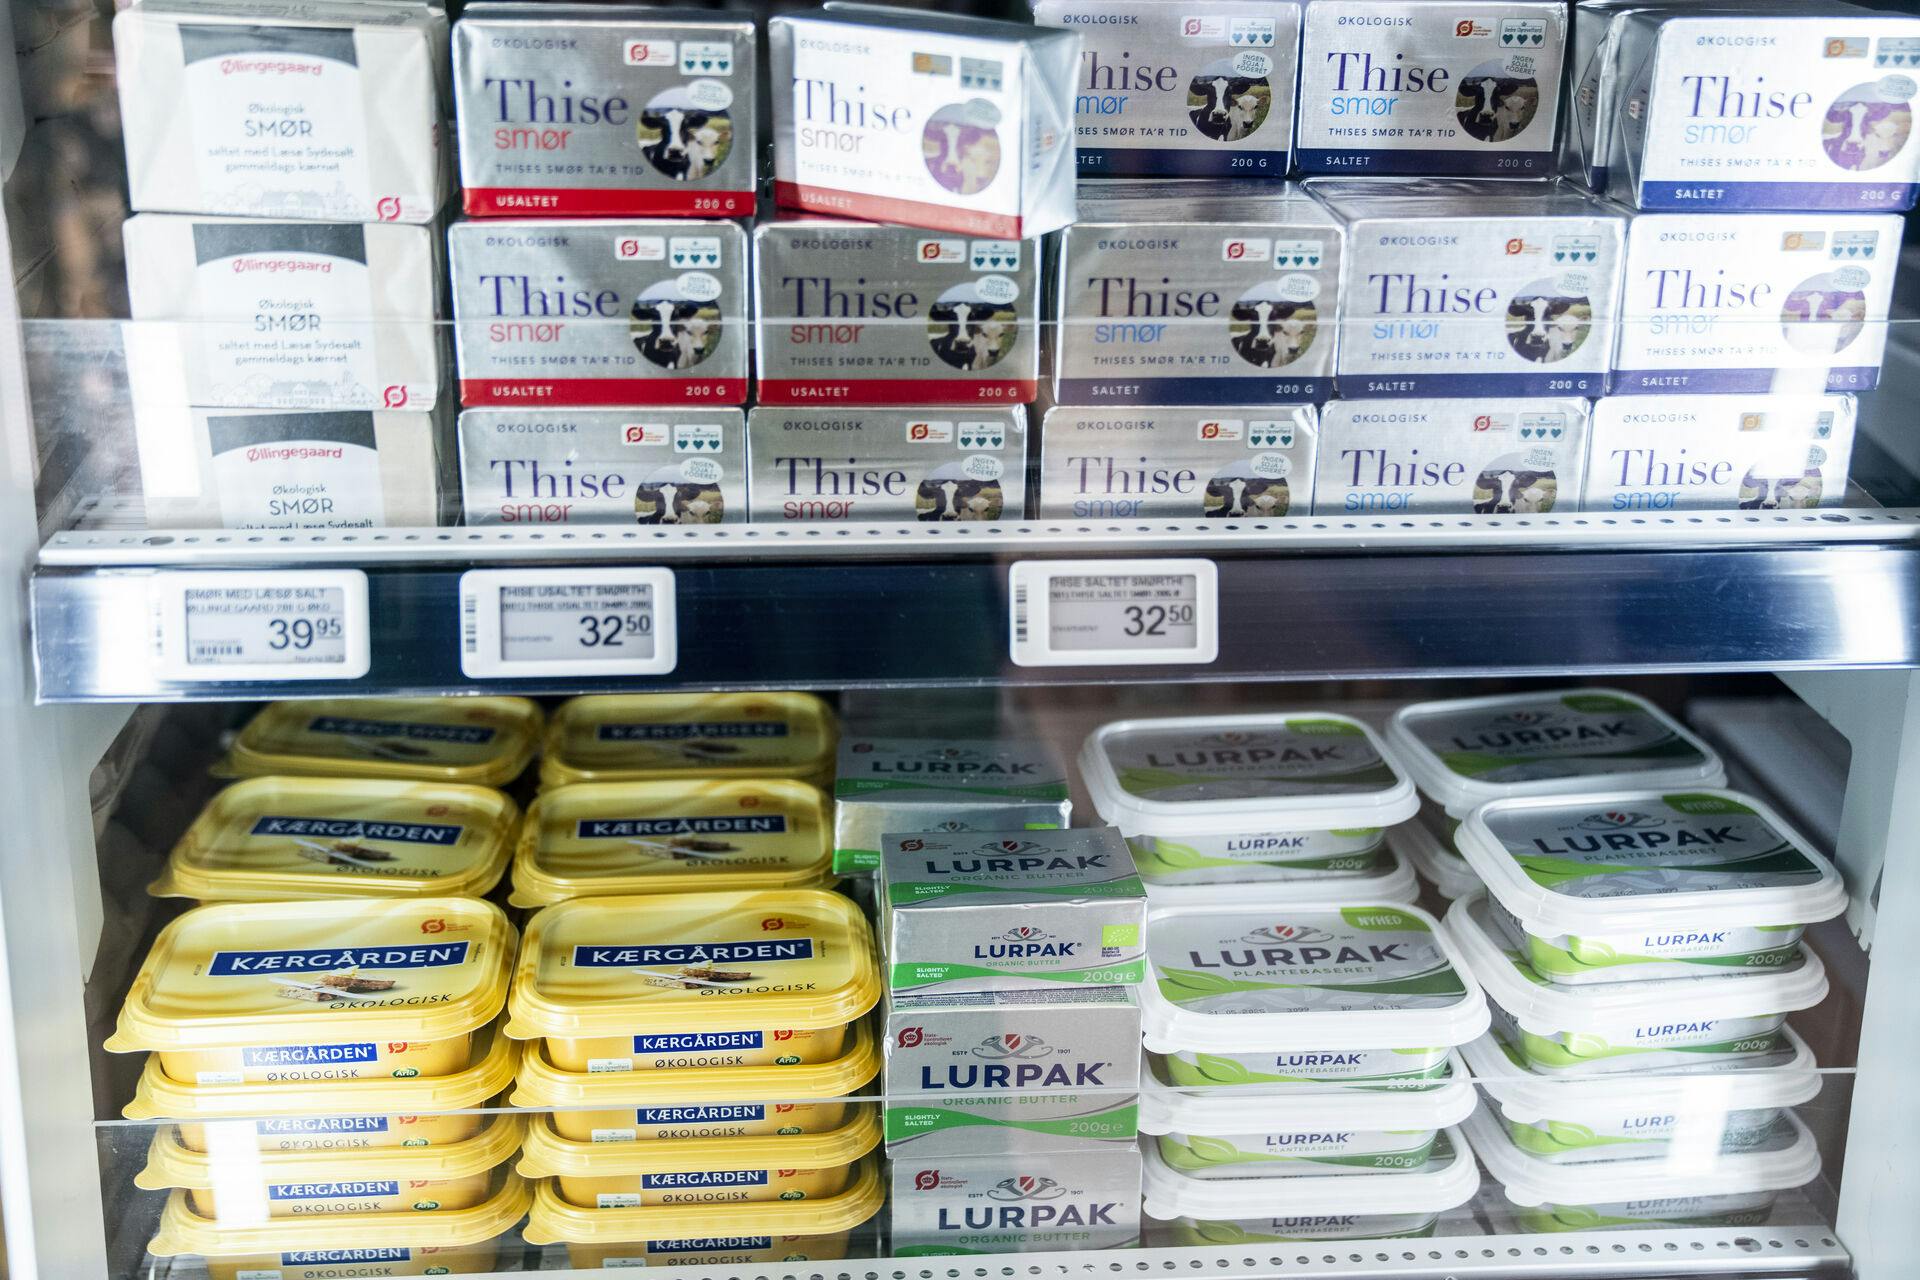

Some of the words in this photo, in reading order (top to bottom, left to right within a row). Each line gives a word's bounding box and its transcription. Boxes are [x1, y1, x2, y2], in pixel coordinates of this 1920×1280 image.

[1063, 14, 1138, 24] ØKOLOGISK
[1338, 17, 1413, 26] ØKOLOGISK
[492, 38, 578, 49] ØKOLOGISK
[1696, 36, 1777, 46] ØKOLOGISK
[220, 59, 323, 75] Øllingegaard
[1512, 55, 1535, 63] INGEN
[1081, 51, 1178, 91] hise
[1327, 52, 1449, 93] Thise
[1505, 65, 1537, 75] FODERET
[485, 78, 629, 126] Thise
[1075, 95, 1128, 114] mør
[1682, 76, 1812, 118] Thise
[793, 78, 911, 133] Thise
[1330, 95, 1399, 116] smør
[244, 119, 313, 138] SMØR
[1328, 128, 1367, 137] THISES
[1371, 128, 1404, 137] SMØR
[1408, 128, 1433, 138] TA'R
[1437, 129, 1456, 138] TID
[1684, 124, 1758, 144] smør
[495, 127, 574, 150] smør
[801, 126, 864, 153] smør
[1231, 158, 1253, 168] 200
[1258, 158, 1267, 168] G
[1326, 156, 1370, 166] SALTET
[1680, 158, 1721, 168] THISES
[1726, 158, 1760, 168] SMØR
[496, 164, 541, 175] THISES
[546, 164, 583, 175] SMØR
[622, 164, 645, 176] TID
[496, 196, 559, 208] USALTET
[1675, 189, 1724, 199] SALTET
[486, 237, 570, 248] ØKOLOGISK
[791, 239, 873, 250] ØKOLOGISK
[1097, 240, 1178, 250] ØKOLOGISK
[1379, 236, 1459, 246] ØKOLOGISK
[1659, 232, 1738, 242] ØKOLOGISK
[232, 259, 333, 274] Øllingegaard
[480, 275, 620, 318] Thise
[1368, 274, 1498, 314] Thise
[1647, 269, 1771, 309] Thise
[782, 277, 918, 319] Thise
[1088, 277, 1220, 318] Thise
[254, 314, 321, 333] SMØR
[489, 321, 565, 342] smør
[790, 322, 864, 344] smør
[1094, 322, 1167, 343] smør
[790, 357, 833, 367] THISES
[839, 357, 874, 367] SMØR
[910, 357, 931, 367] TID
[1094, 356, 1135, 366] THISES
[1140, 356, 1174, 366] SMØR
[1210, 355, 1230, 366] TID
[1091, 385, 1140, 396] SALTET
[1368, 381, 1416, 392] SALTET
[1642, 377, 1689, 388] SALTET
[492, 386, 554, 397] USALTET
[791, 386, 850, 397] USALTET
[783, 421, 863, 431] ØKOLOGISK
[1077, 420, 1155, 431] ØKOLOGISK
[1352, 414, 1428, 424] ØKOLOGISK
[1623, 413, 1697, 424] ØKOLOGISK
[497, 423, 578, 433] ØKOLOGISK
[246, 448, 342, 462] Øllingegaard
[1067, 456, 1196, 495] Thise
[1341, 449, 1465, 487] Thise
[1611, 448, 1732, 487] Thise
[490, 459, 626, 499] Thise
[775, 457, 906, 496] Thise
[272, 485, 327, 497] Økologisk
[269, 498, 334, 516] SMØR
[1072, 498, 1144, 518] smør
[1344, 491, 1413, 511] smør
[1612, 490, 1681, 510] smør
[500, 503, 573, 523] smør
[784, 500, 855, 520] smør
[1085, 576, 1128, 587] SALTET
[296, 588, 326, 599] SALT
[1124, 605, 1166, 636] 32
[1169, 604, 1193, 622] 50
[269, 618, 314, 650] 39
[316, 617, 341, 636] 95
[580, 615, 623, 647] 32
[626, 614, 650, 633] 50
[1452, 722, 1637, 751] LURPAK
[1147, 745, 1345, 767] LURPAK
[872, 760, 1036, 775] LURPAK
[267, 817, 445, 842] KÆRGÅRDEN
[594, 816, 772, 836] KÆRGÅRDEN
[1228, 837, 1306, 851] LURPAK
[1533, 826, 1746, 855] LURPAK
[1584, 848, 1718, 862] PLANTEBASERET
[926, 854, 1109, 874] LURPAK
[1357, 915, 1402, 926] NYHED
[1644, 931, 1728, 948] LURPAK
[593, 943, 798, 965] KÆRGÅRDEN
[975, 942, 1076, 959] LURPAK
[1189, 942, 1408, 969] LURPAK
[231, 946, 453, 972] KÆRGÅRDEN
[986, 959, 1025, 968] ORGANIC
[1027, 958, 1061, 967] BUTTER
[1233, 965, 1375, 978] PLANTEBASERET
[701, 981, 817, 997] ØKOLOGISK
[330, 993, 453, 1010] ØKOLOGISK
[1635, 1021, 1715, 1039] LURPAK
[643, 1032, 756, 1051] KÆRGÅRDEN
[252, 1045, 370, 1064] KÆRGÅRDEN
[655, 1055, 743, 1068] ØKOLOGISK
[778, 1056, 799, 1065] Arla
[1276, 1053, 1362, 1067] LURPAK
[267, 1068, 359, 1081] ØKOLOGISK
[922, 1062, 1106, 1089] LURPAK
[1278, 1066, 1359, 1074] PLANTEBASERET
[943, 1095, 1013, 1106] ORGANIC
[1020, 1094, 1078, 1105] BUTTER
[646, 1106, 758, 1122] KÆRGÅRDEN
[1623, 1115, 1676, 1131] LURP
[658, 1126, 745, 1139] ØKOLOGISK
[1266, 1132, 1350, 1147] LURPAK
[280, 1137, 370, 1149] ØKOLOGISK
[651, 1170, 761, 1186] KÆRGÅRDEN
[277, 1181, 391, 1197] KÆRGÅRDEN
[662, 1191, 749, 1203] ØKOLOGISK
[292, 1201, 381, 1213] ØKOLOGISK
[938, 1203, 1118, 1230] LURPAK
[1272, 1214, 1356, 1228] LURPAK
[959, 1233, 1027, 1244] ORGANIC
[1033, 1231, 1090, 1242] BUTTER
[667, 1255, 753, 1266] ØKOLOGISK
[304, 1267, 392, 1279] ØKOLOGISK
